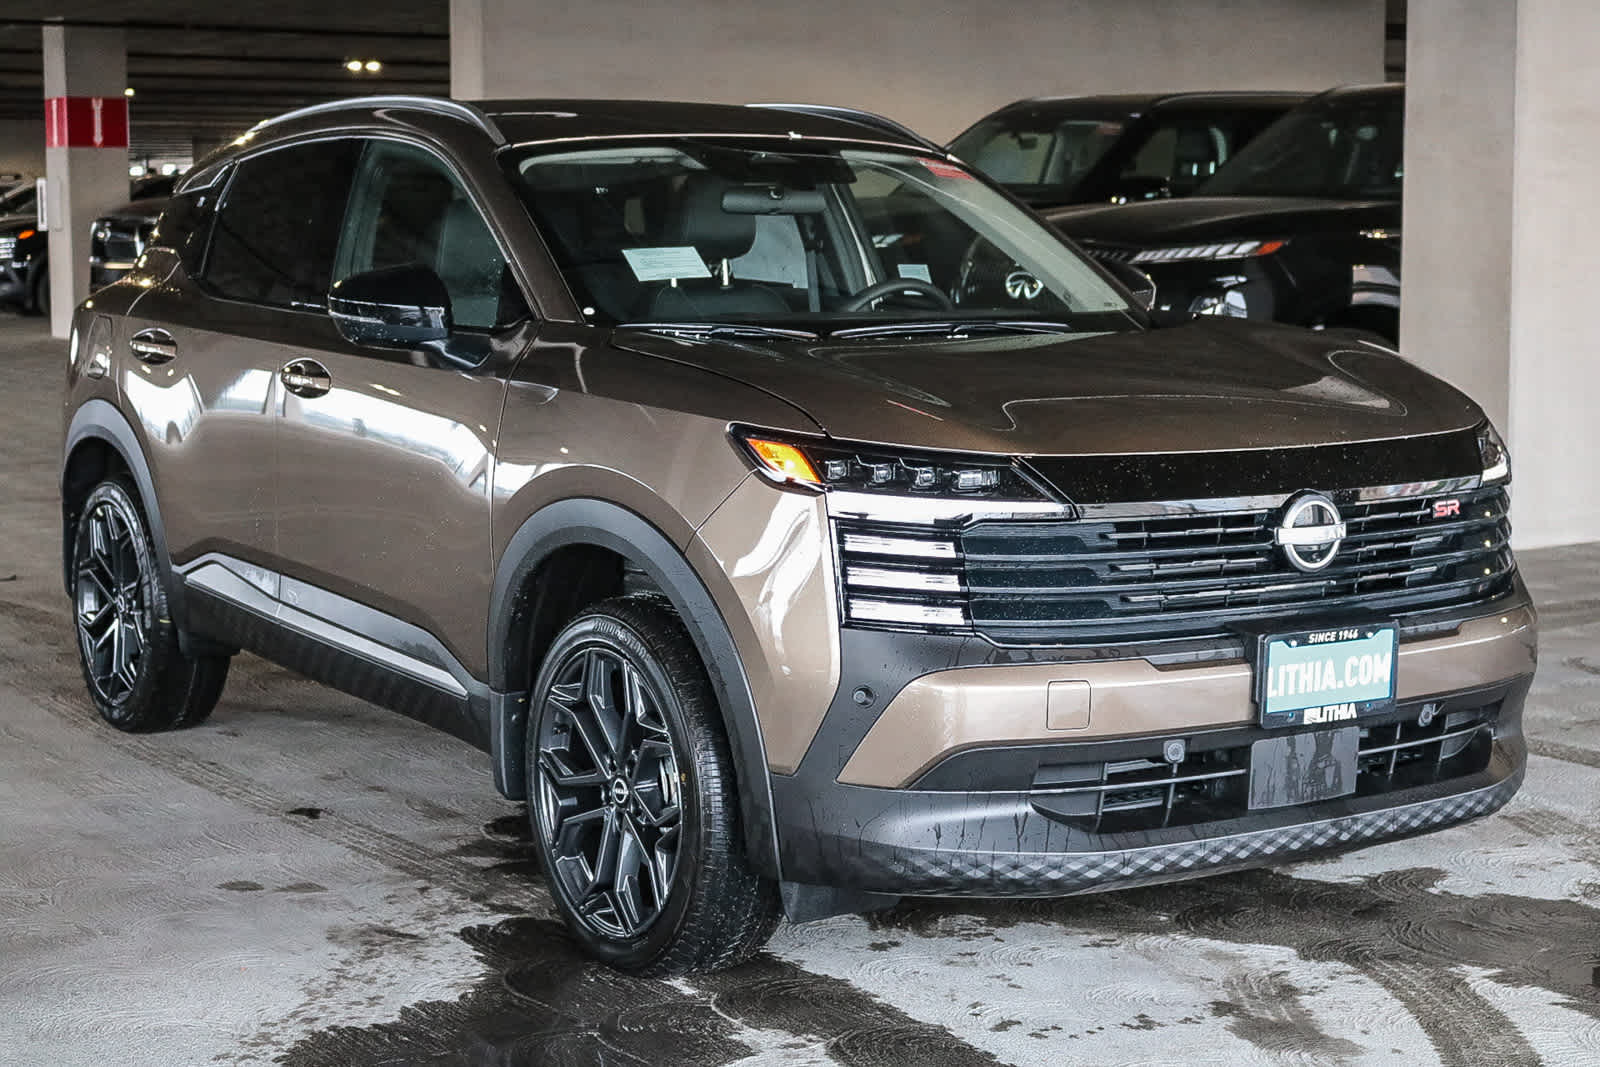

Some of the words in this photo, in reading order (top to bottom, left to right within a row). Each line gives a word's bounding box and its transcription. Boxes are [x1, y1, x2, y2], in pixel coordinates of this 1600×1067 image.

[1434, 499, 1461, 517] SR
[1308, 631, 1337, 644] SINCE
[1267, 652, 1391, 697] LITHIA.COM
[1316, 702, 1358, 722] LITHIA
